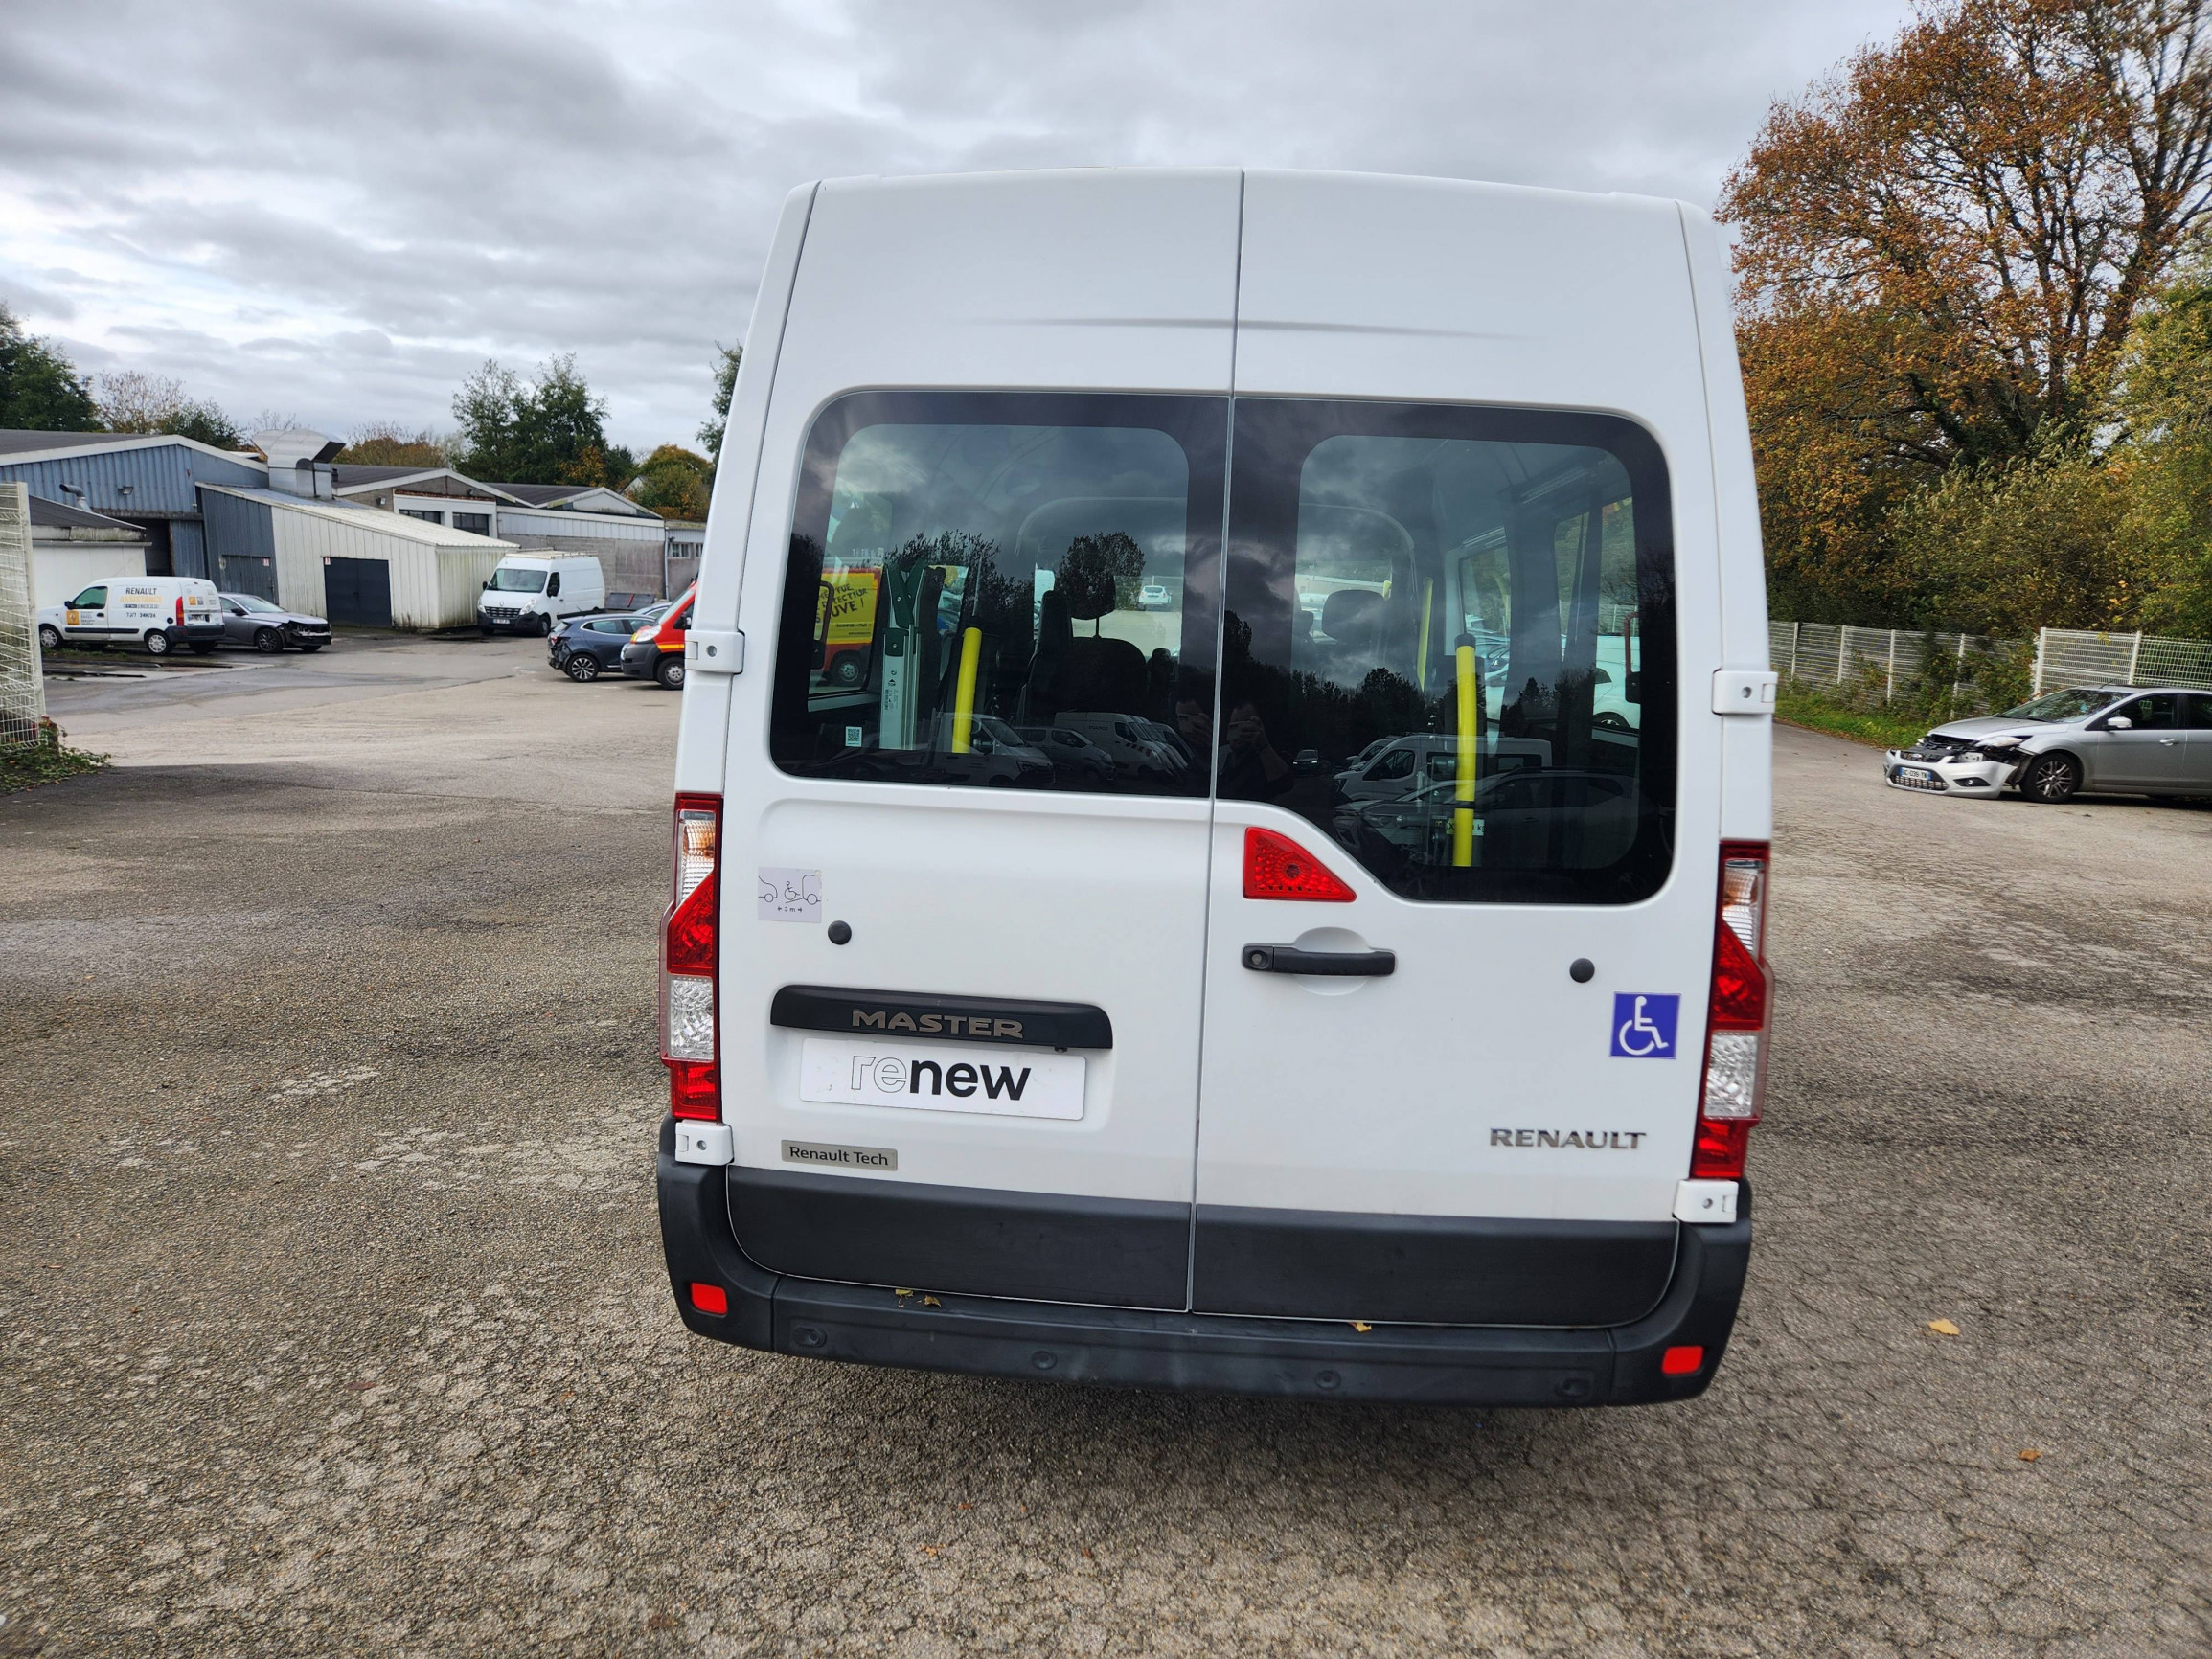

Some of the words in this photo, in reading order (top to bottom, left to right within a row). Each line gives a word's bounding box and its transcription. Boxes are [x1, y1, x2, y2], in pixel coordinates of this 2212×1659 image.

[851, 1010, 1023, 1039] MASTER
[851, 1055, 1032, 1101] renew
[1490, 1128, 1647, 1149] RENAULT
[789, 1146, 850, 1164] Renault
[853, 1151, 888, 1166] Tech
